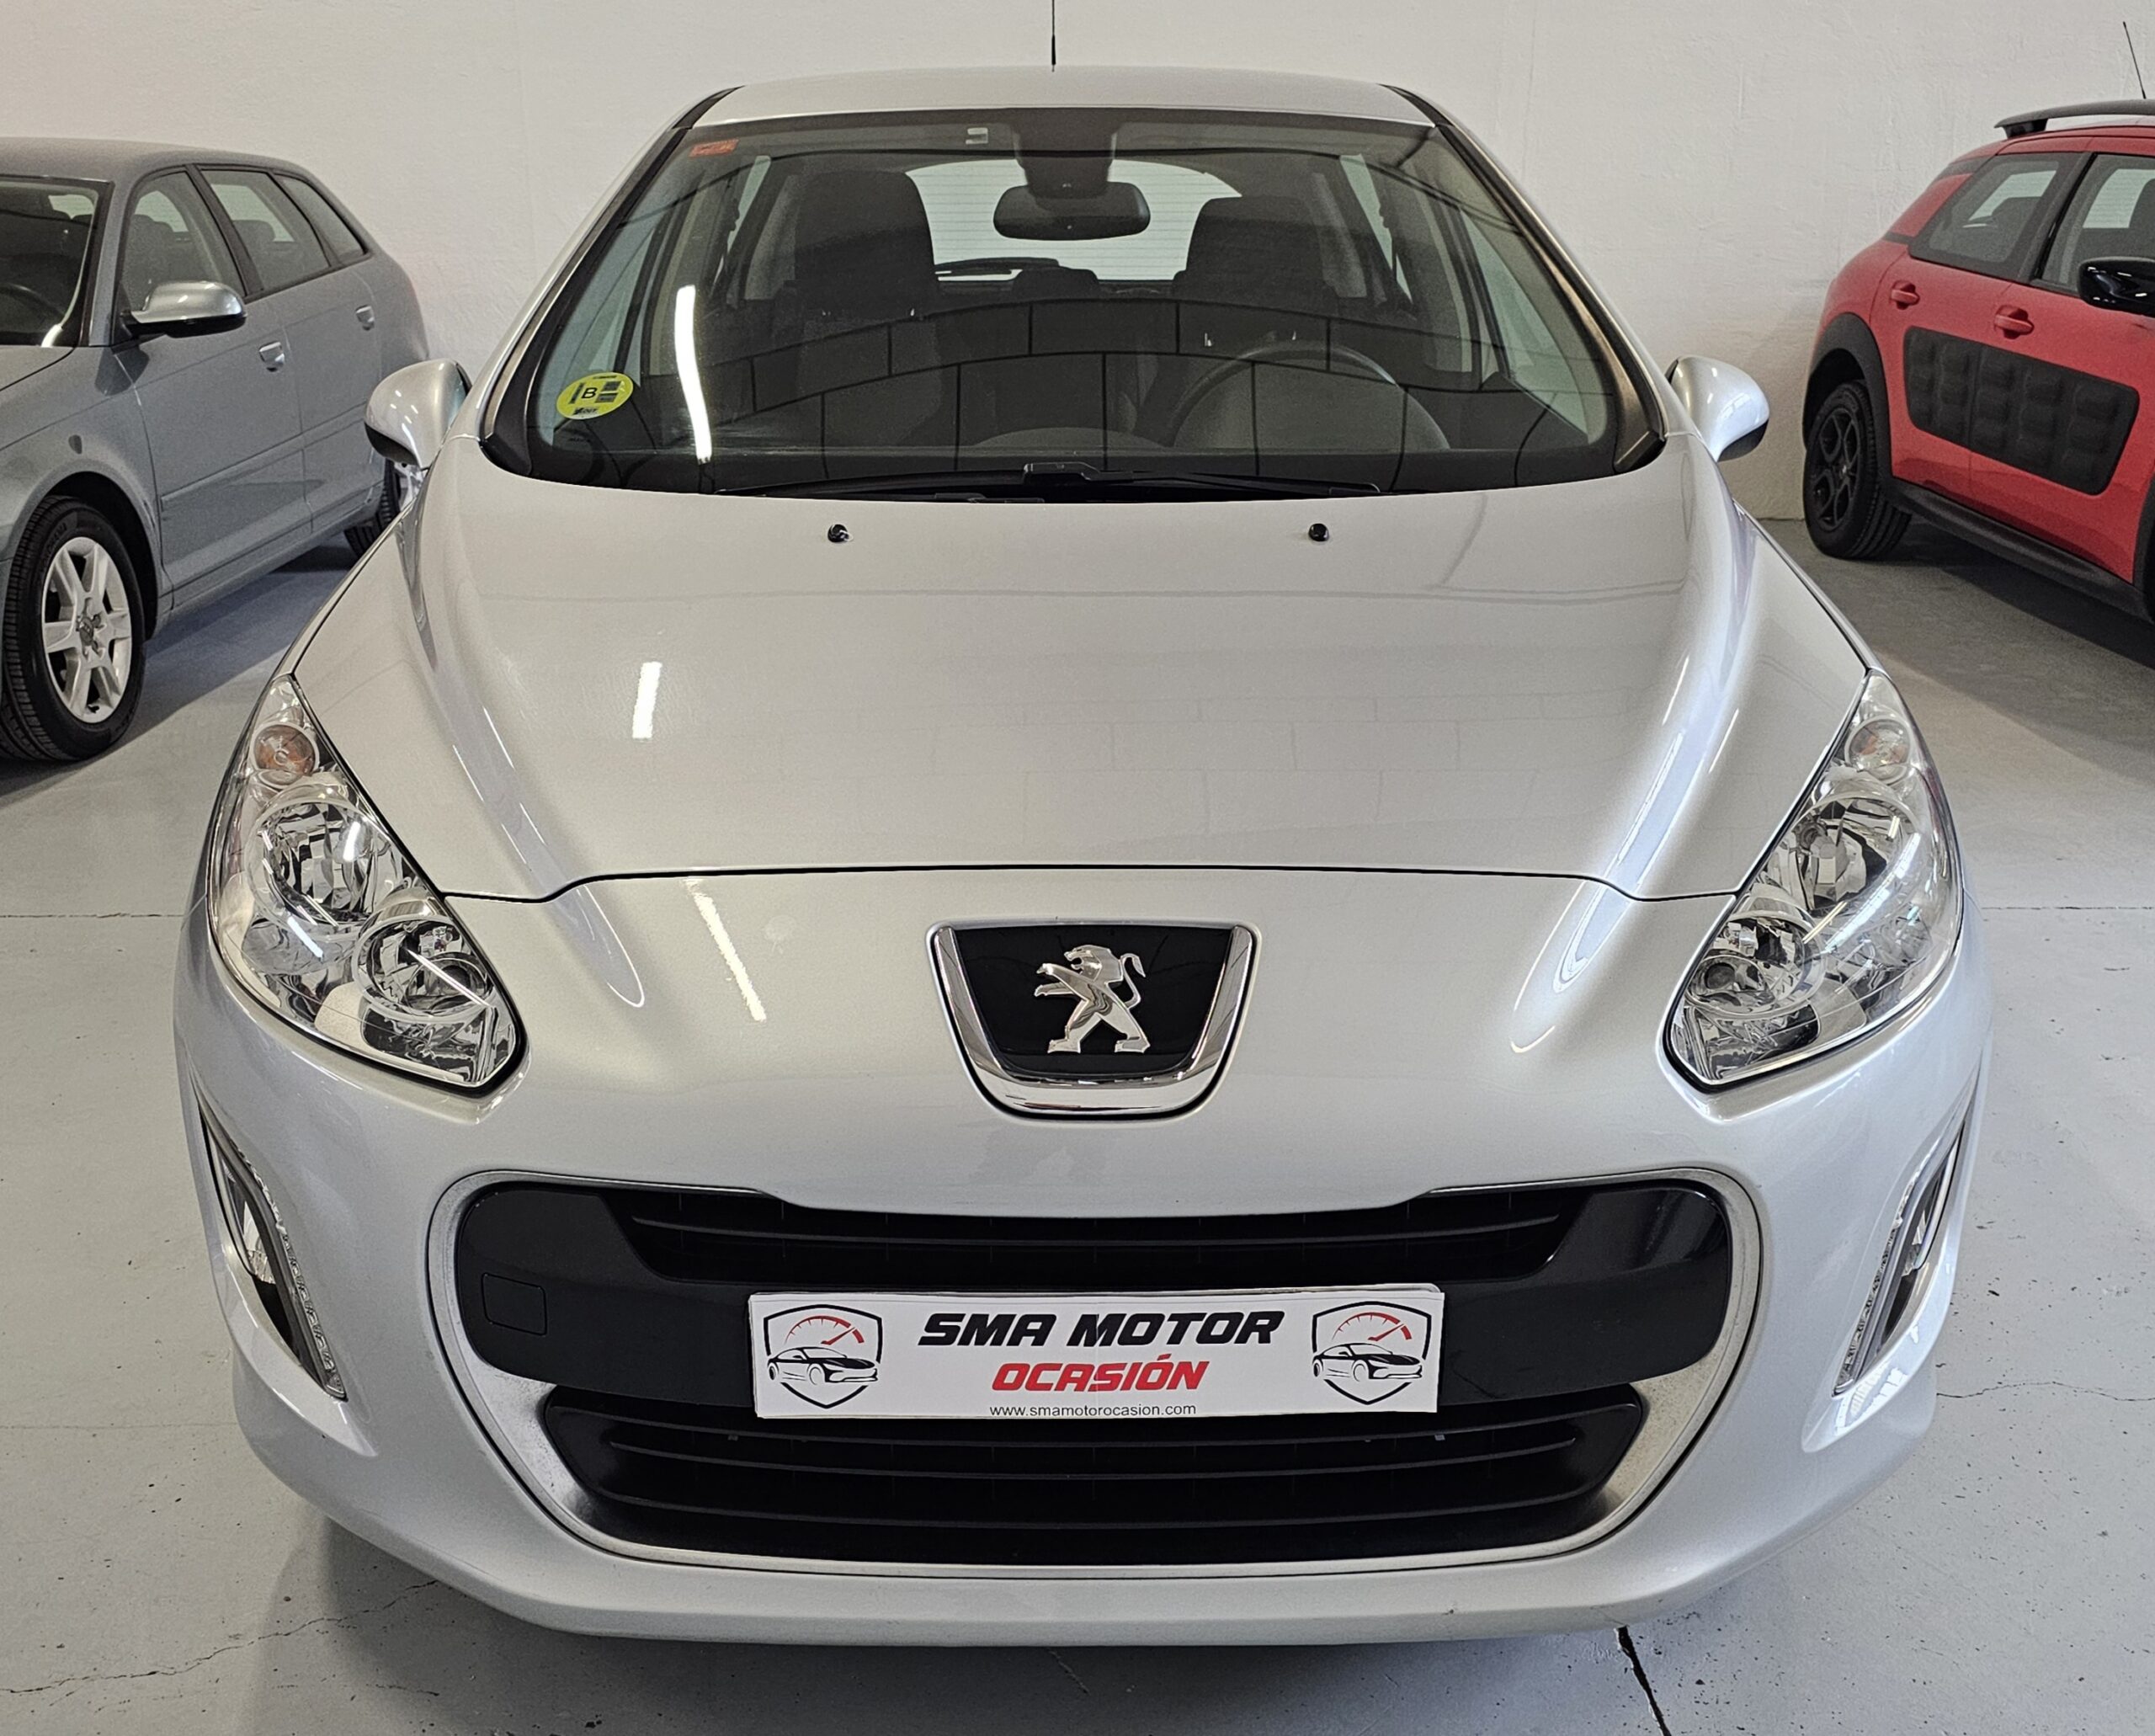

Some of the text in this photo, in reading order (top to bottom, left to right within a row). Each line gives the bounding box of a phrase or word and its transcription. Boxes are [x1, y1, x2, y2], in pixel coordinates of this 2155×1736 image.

[582, 387, 598, 399] B
[918, 1311, 1285, 1347] SMA MOTOR
[992, 1353, 1210, 1393] OCASIÓN
[989, 1403, 1196, 1416] www.smamotorocasion.com
